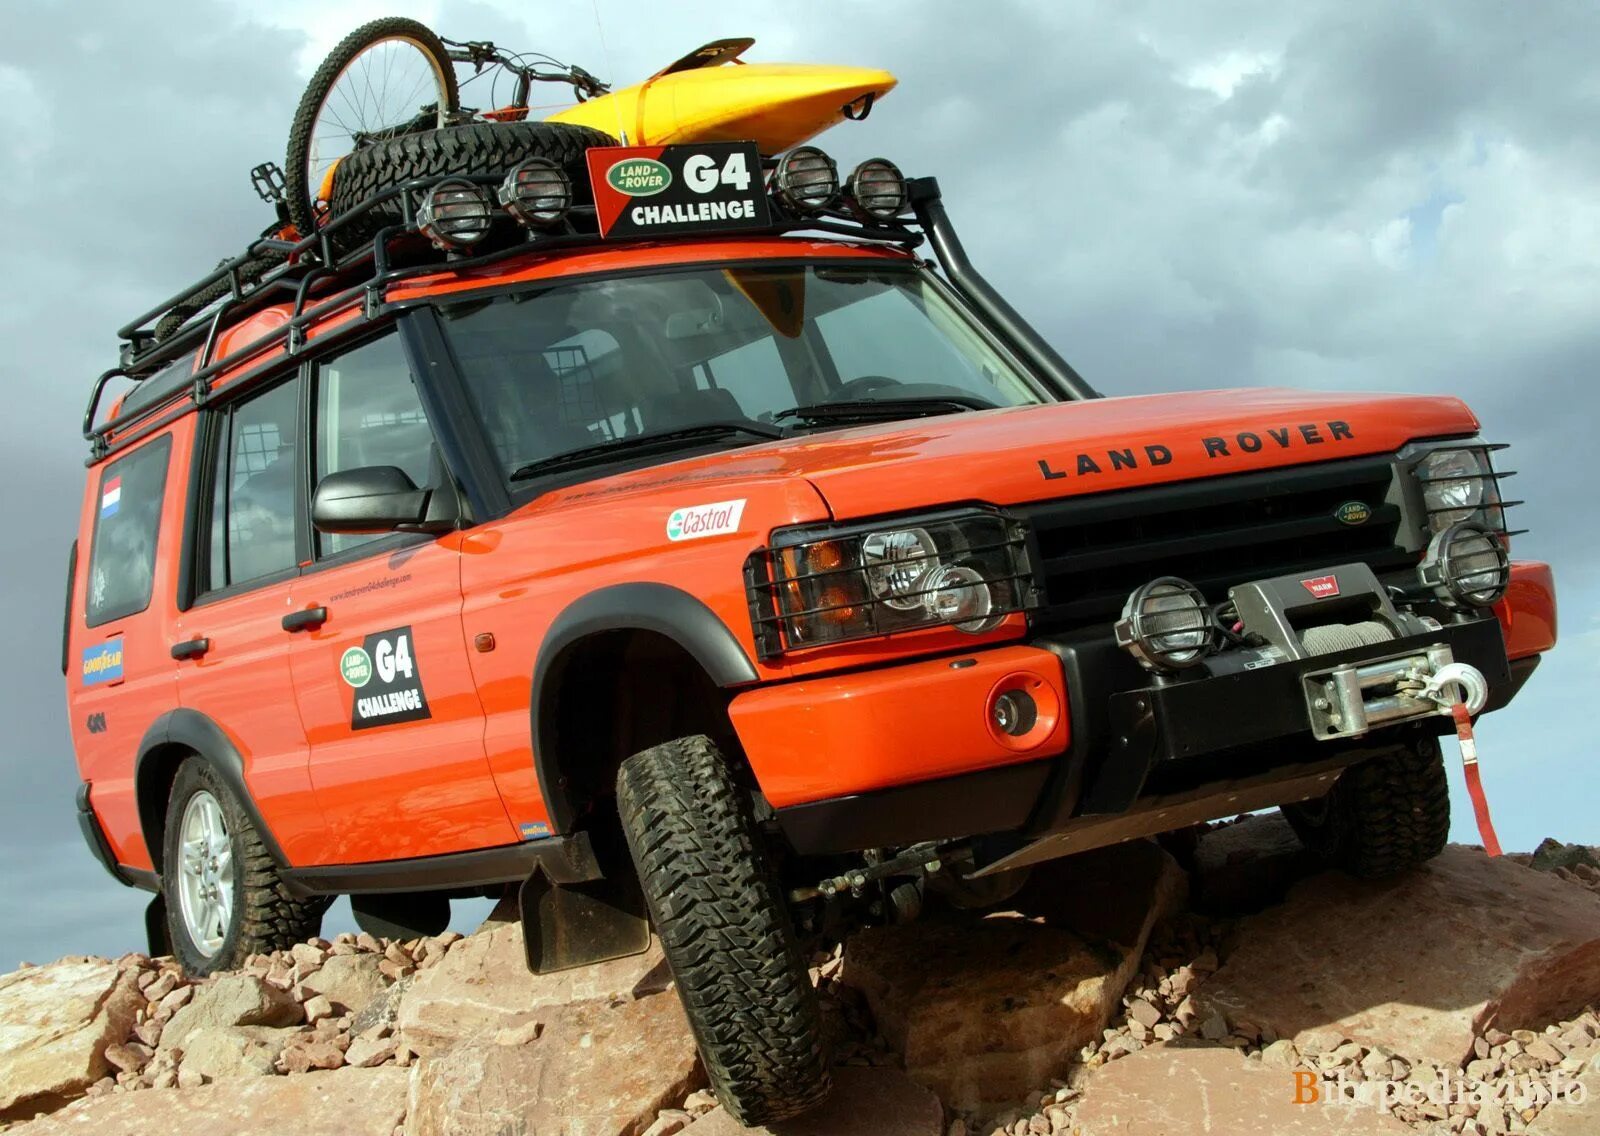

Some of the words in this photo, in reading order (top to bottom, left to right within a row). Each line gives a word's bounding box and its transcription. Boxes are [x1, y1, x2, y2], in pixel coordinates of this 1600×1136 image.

[620, 165, 650, 178] LAND
[683, 152, 751, 194] G4
[625, 175, 663, 188] ROVER
[631, 200, 756, 226] CHALLENGE
[1037, 444, 1173, 481] LAND
[1201, 420, 1354, 459] ROVER
[1344, 505, 1361, 514] LAND
[1347, 511, 1367, 521] ROVER
[683, 504, 733, 535] Castrol
[1312, 582, 1333, 592] WARN
[345, 654, 361, 668] LAND
[375, 635, 413, 683] G4
[349, 664, 368, 679] ROVER
[357, 688, 422, 719] CHALLENGE
